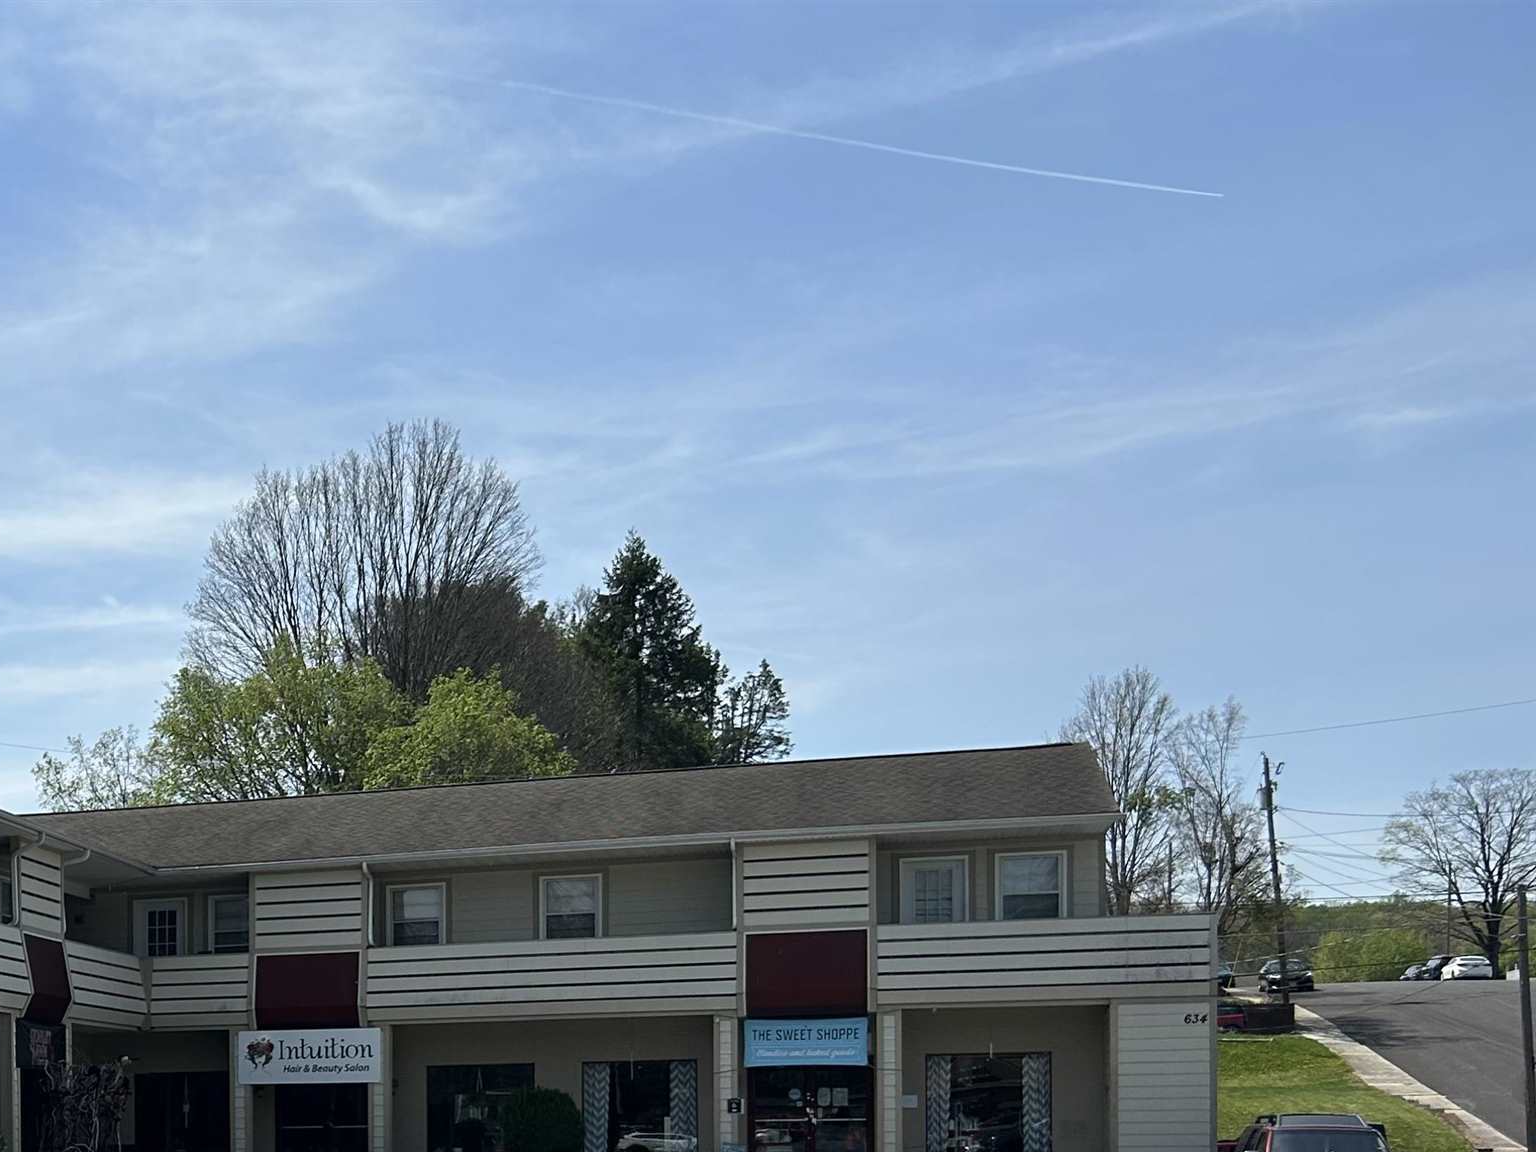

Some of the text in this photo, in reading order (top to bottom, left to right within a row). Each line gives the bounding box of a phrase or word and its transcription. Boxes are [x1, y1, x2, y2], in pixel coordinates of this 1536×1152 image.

[1184, 1013, 1208, 1024] 634
[752, 1028, 859, 1040] THE SWEET SHOPPE
[279, 1038, 374, 1060] Intuition
[284, 1063, 369, 1074] Hair & Beauty Salon
